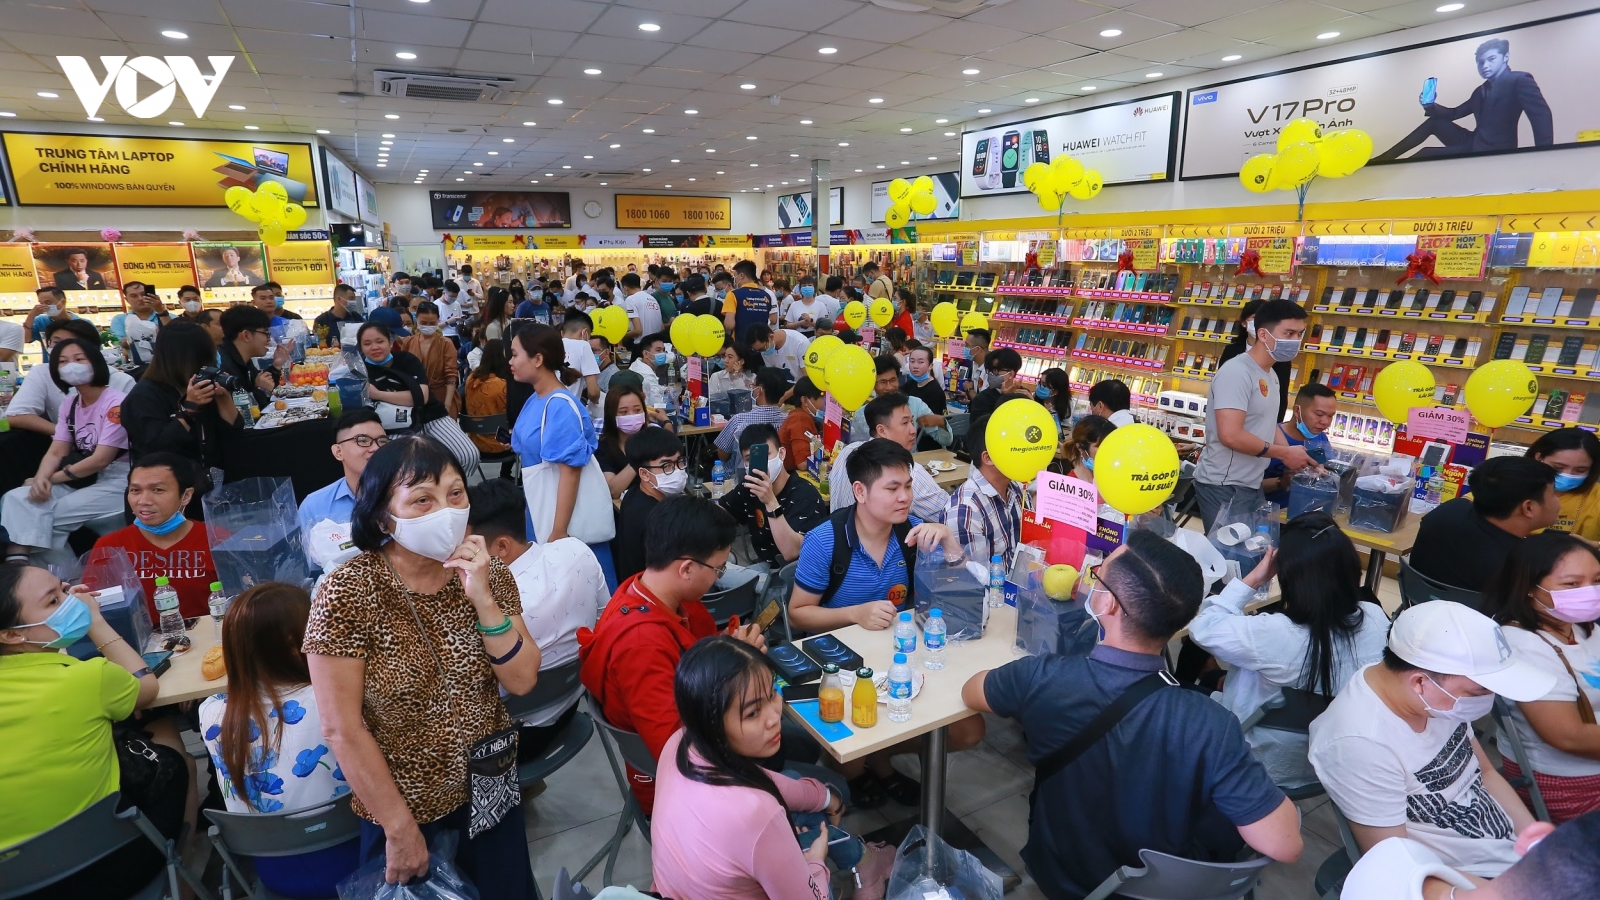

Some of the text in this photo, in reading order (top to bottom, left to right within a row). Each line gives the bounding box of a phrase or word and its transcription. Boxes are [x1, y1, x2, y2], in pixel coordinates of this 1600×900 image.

[1197, 93, 1214, 102] vivo
[1144, 104, 1169, 114] HUAWEI
[1244, 128, 1270, 139] Vượt
[1327, 117, 1353, 129] Ảnh
[1062, 137, 1101, 152] HUAWEI
[1103, 133, 1132, 146] WATCH
[1134, 130, 1148, 143] FIT
[35, 147, 175, 162] TRUNG TÂM LAPTOP
[39, 160, 87, 174] CHÍNH
[54, 182, 79, 190] 100%
[80, 182, 125, 191] WINDOWS
[625, 208, 670, 220] 1800 1060
[682, 210, 725, 221] 1800 1062
[1243, 225, 1286, 236] DƯỚI 2 TRIỆU
[1413, 220, 1473, 232] DƯỚI 3 TRIỆU
[312, 231, 328, 240] 50%
[1138, 228, 1153, 237] TRIỆU
[1421, 237, 1454, 249] HOT
[1456, 235, 1476, 243] HÔM
[1248, 240, 1271, 250] HOT
[1539, 241, 1547, 251] 6
[1418, 410, 1465, 424] GIẢM 30%
[1130, 471, 1150, 482] TRẢ
[1152, 471, 1169, 482] GÓP
[1048, 479, 1095, 503] GIẢM 30%
[1139, 482, 1156, 492] LÃI
[127, 549, 207, 571] DESIRE
[888, 589, 908, 601] 032
